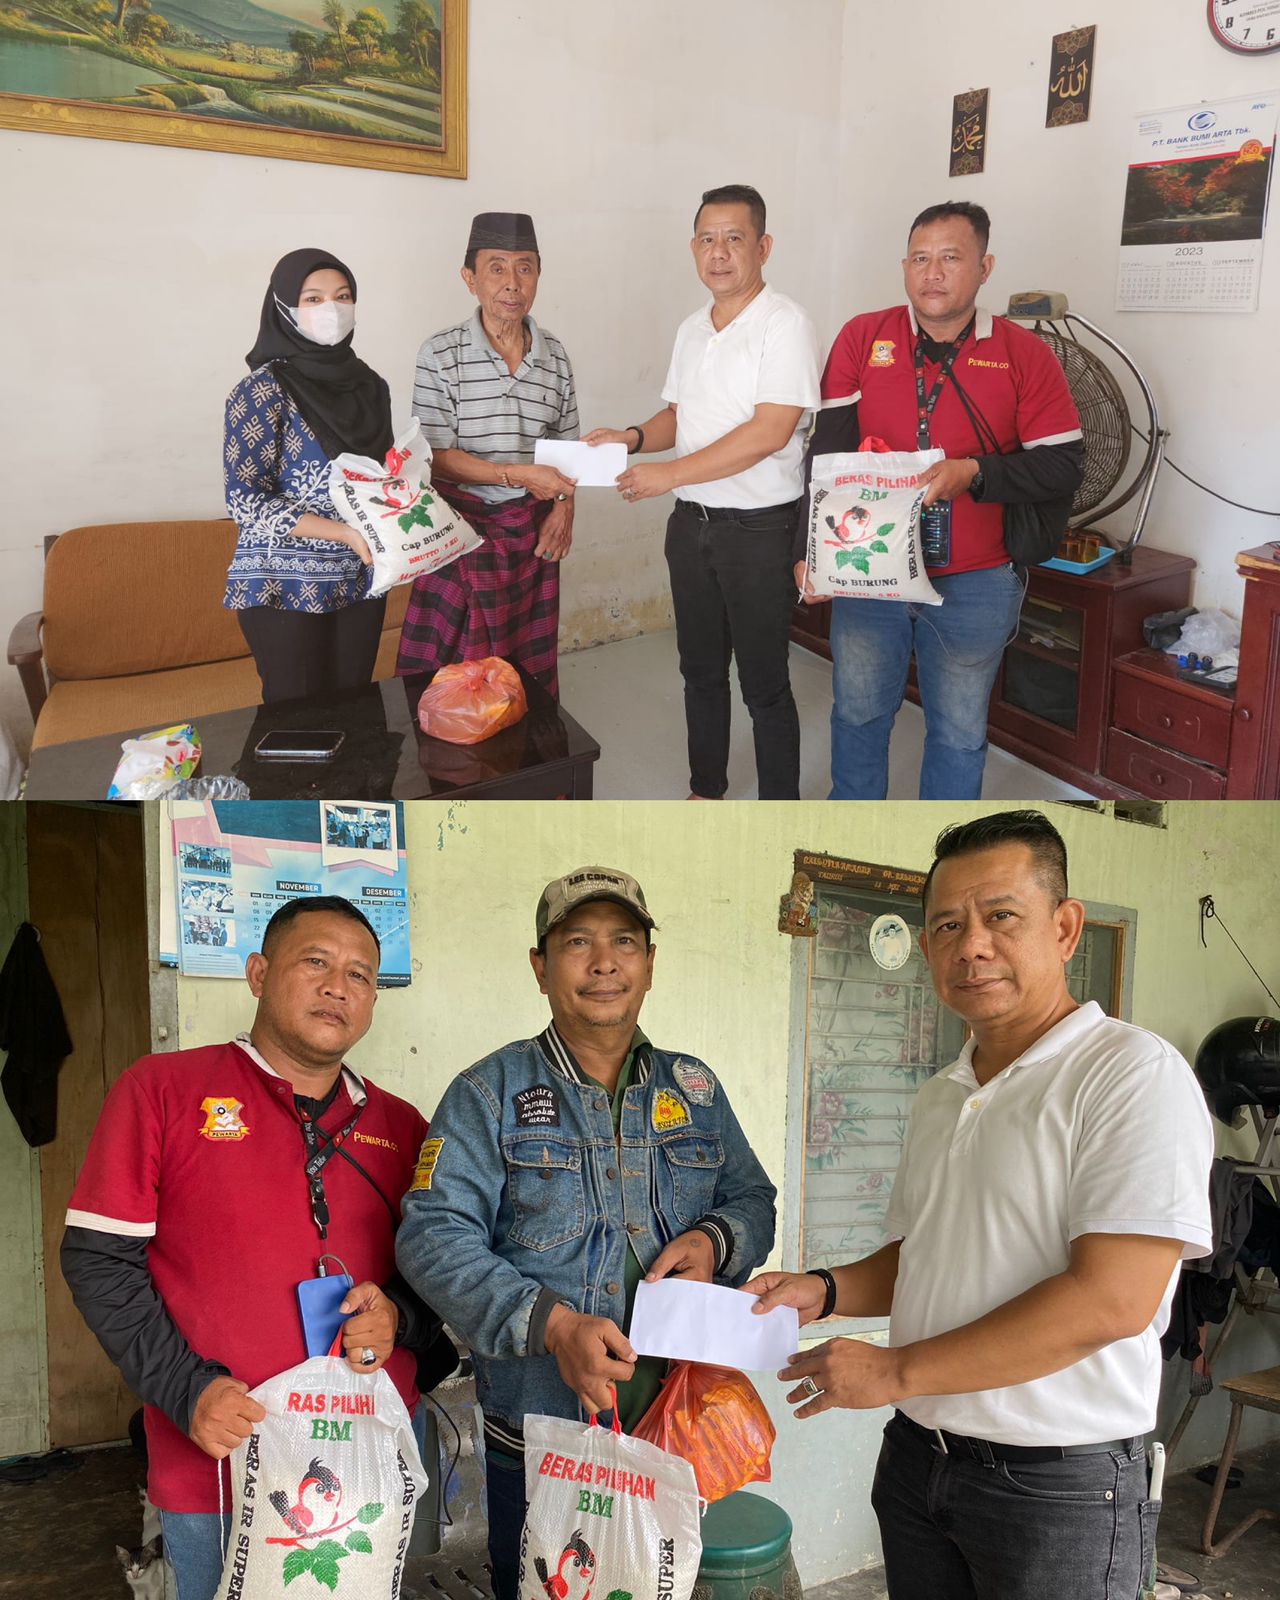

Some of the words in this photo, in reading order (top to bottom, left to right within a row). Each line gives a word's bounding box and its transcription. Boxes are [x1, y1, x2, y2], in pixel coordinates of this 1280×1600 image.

[1225, 16, 1234, 29] 8
[1243, 27, 1251, 40] 7
[1266, 27, 1276, 41] 6
[1166, 137, 1189, 146] BANK
[1191, 132, 1211, 142] BUMI
[1212, 129, 1232, 139] ARTA
[1235, 126, 1251, 136] Tbk.
[1175, 247, 1204, 256] 2023
[834, 474, 873, 488] BERAS
[812, 488, 829, 519] BERAS
[858, 488, 889, 501] BM
[364, 523, 386, 554] SUPER
[401, 541, 421, 552] Cap
[423, 522, 455, 545] BURUNG
[408, 548, 440, 565] BRUTTO
[908, 539, 918, 580] BERAS
[828, 575, 848, 587] Cap
[851, 577, 898, 587] BURUNG
[279, 882, 319, 892] NOVEMBER
[569, 873, 585, 886] LEE
[366, 888, 402, 897] DESEMBER
[310, 1418, 352, 1442] BM
[244, 1433, 260, 1499] BERAS
[538, 1452, 592, 1484] BERAS
[595, 1465, 657, 1502] PILIHAN
[576, 1489, 614, 1519] BM
[240, 1503, 254, 1528] IR
[226, 1533, 250, 1600] SUPER
